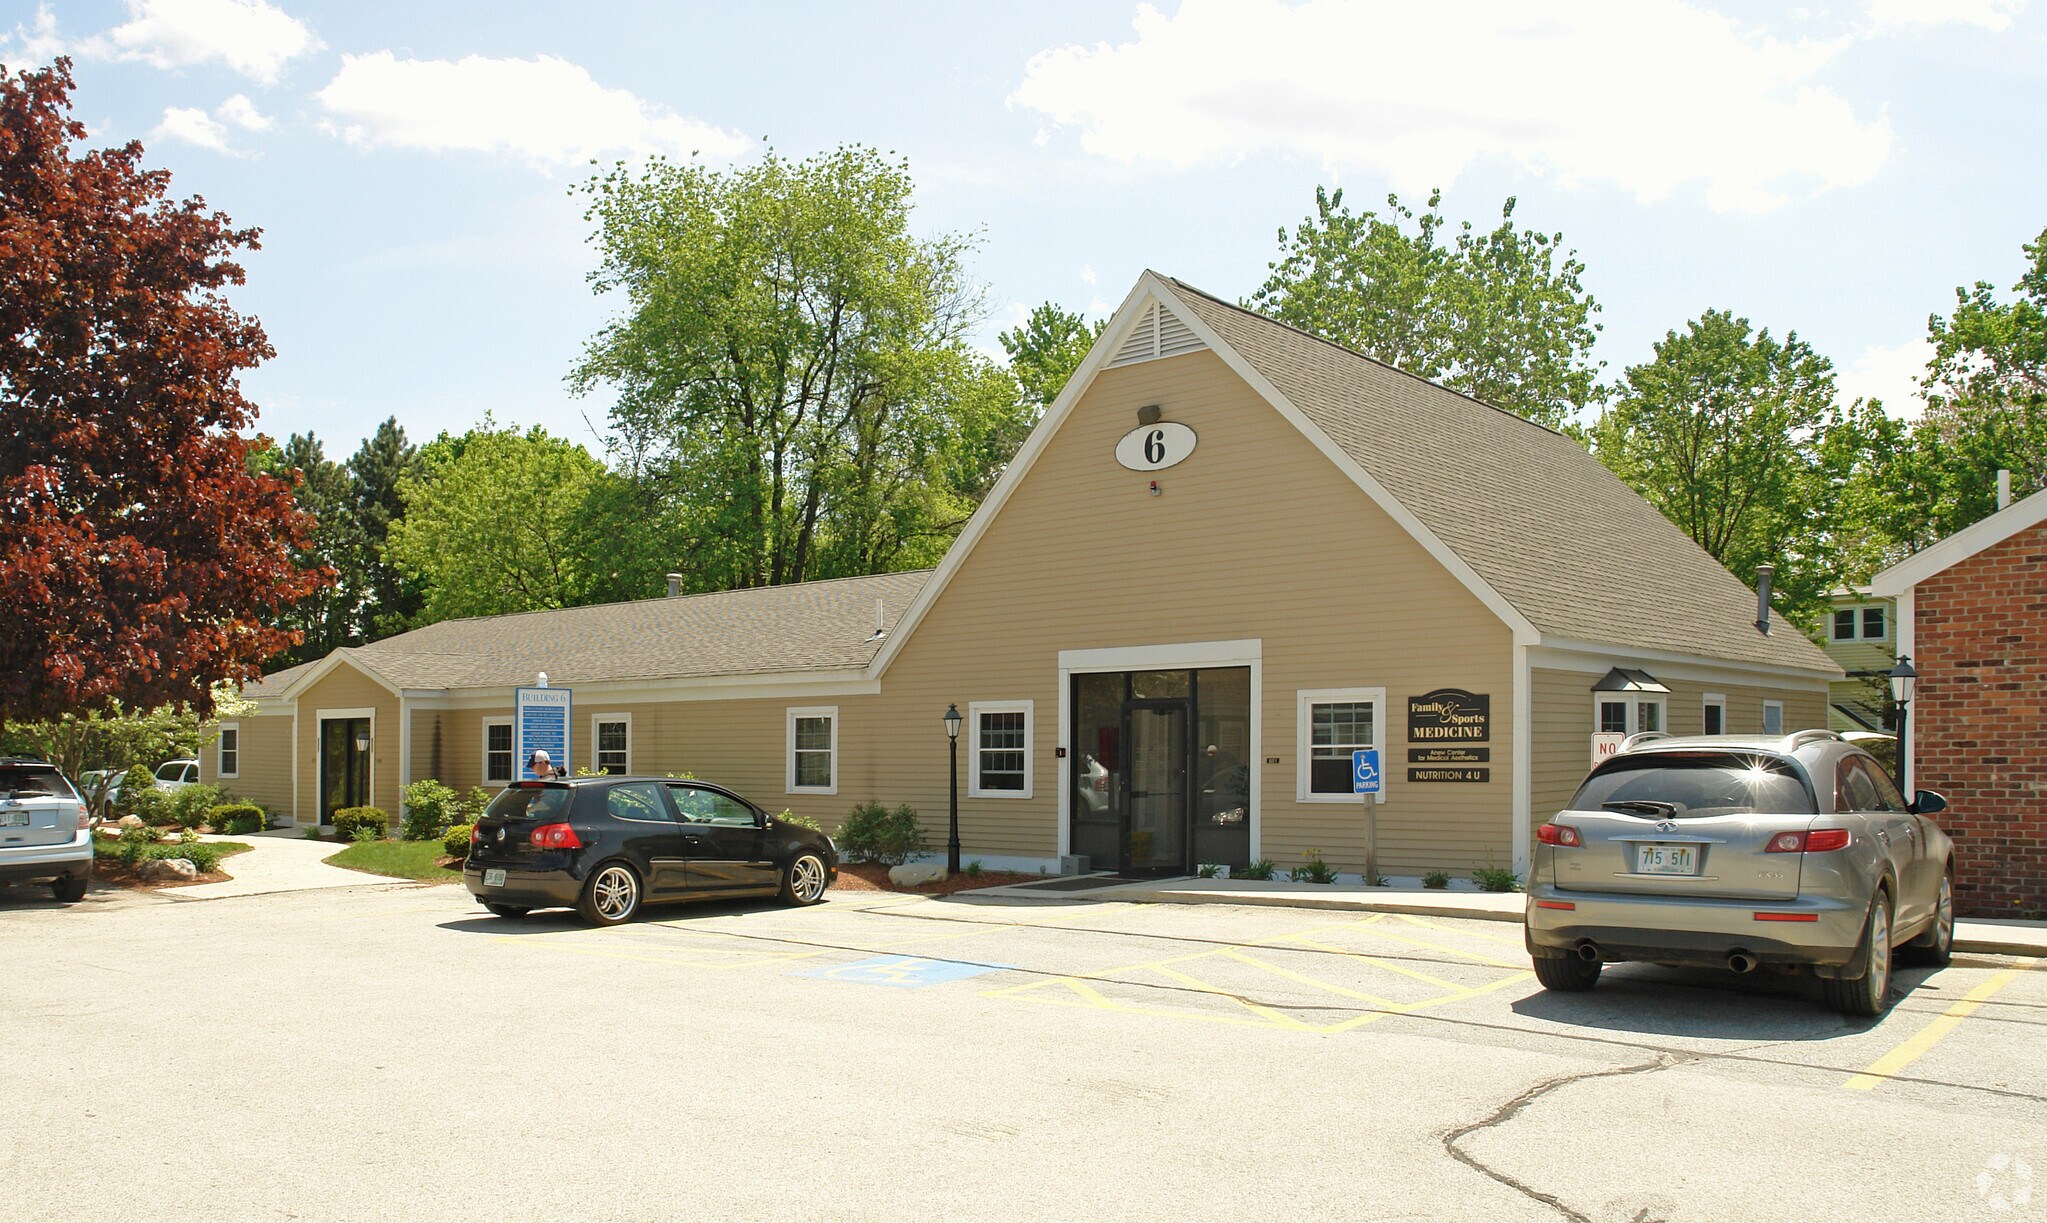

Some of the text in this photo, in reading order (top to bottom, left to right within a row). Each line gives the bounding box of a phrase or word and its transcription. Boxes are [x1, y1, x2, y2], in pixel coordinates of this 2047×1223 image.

[1145, 430, 1165, 463] 6
[523, 693, 566, 702] BUILDING 6
[1411, 701, 1459, 723] Family &
[1452, 714, 1485, 725] Sports
[1413, 727, 1482, 738] MEDICINE
[1600, 743, 1616, 754] NO
[1416, 771, 1480, 780] NUTRITION 4 U
[1356, 781, 1378, 789] PARKING
[1643, 851, 1662, 864] 715
